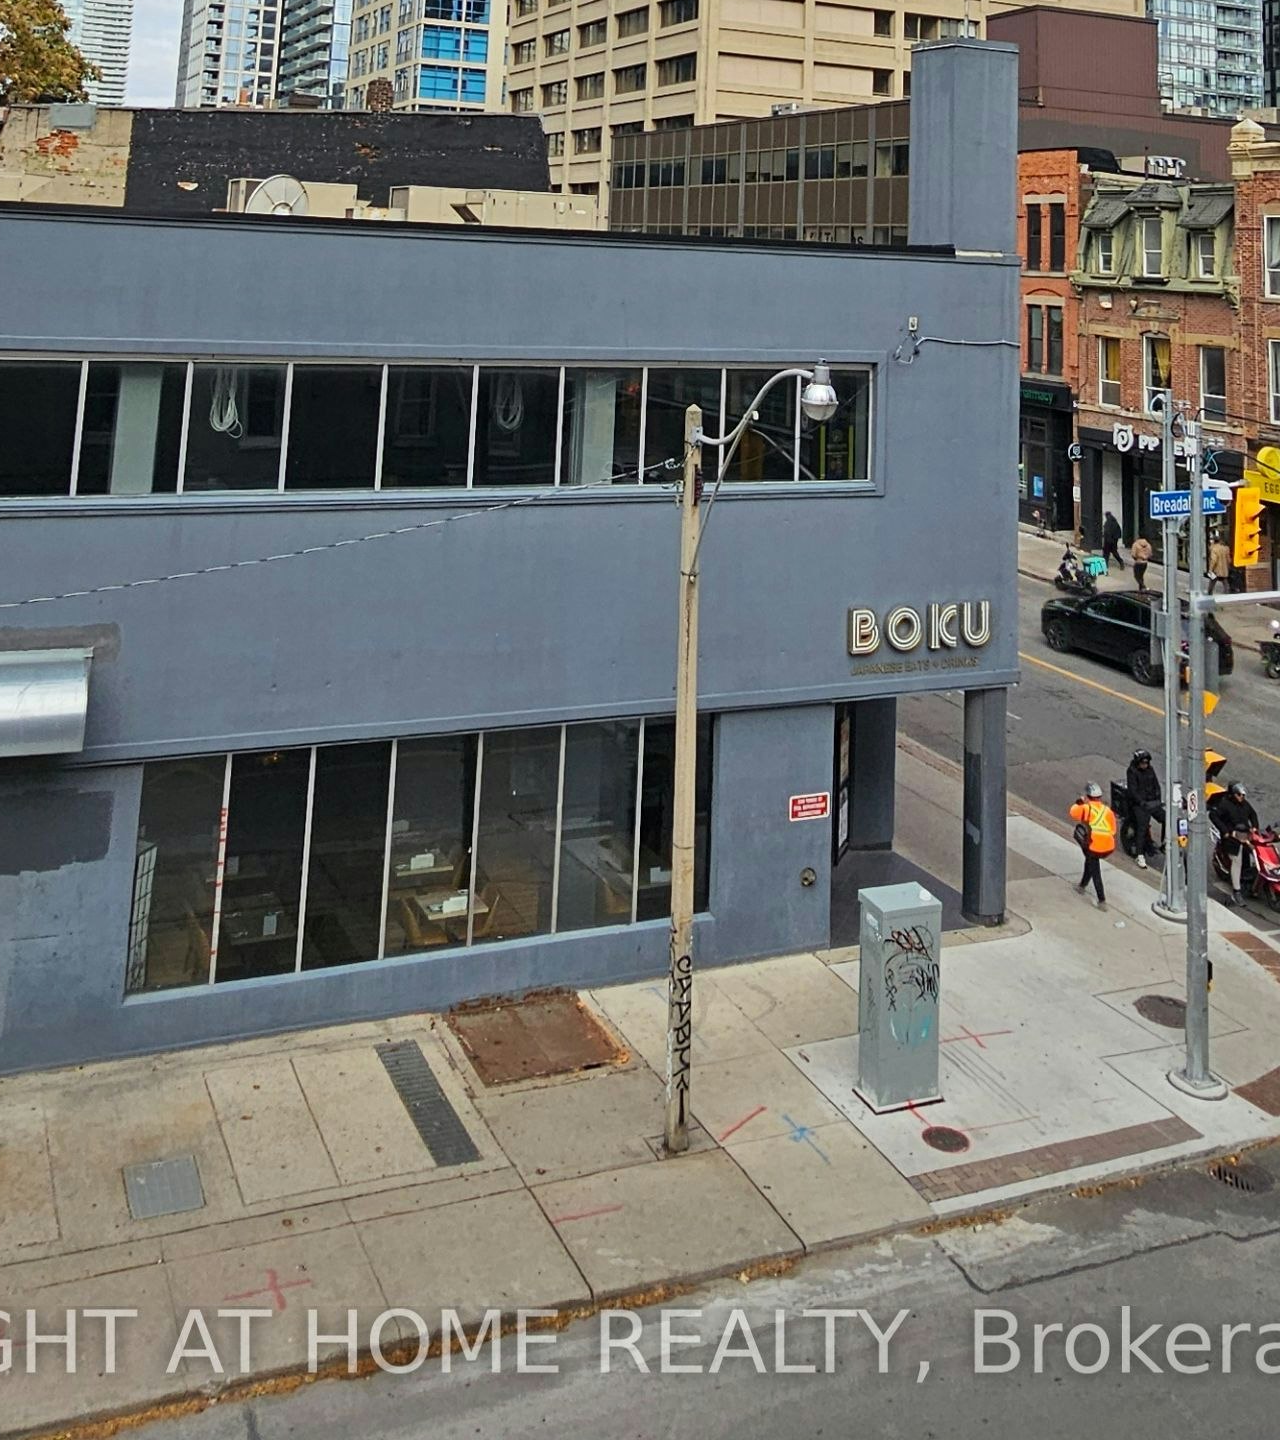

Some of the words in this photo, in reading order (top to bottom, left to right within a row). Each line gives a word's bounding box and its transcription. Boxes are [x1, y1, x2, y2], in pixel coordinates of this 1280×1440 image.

[1022, 388, 1053, 406] armacy
[1264, 482, 1280, 495] EGG
[1153, 495, 1216, 513] Breadalne
[848, 600, 991, 656] BOKU
